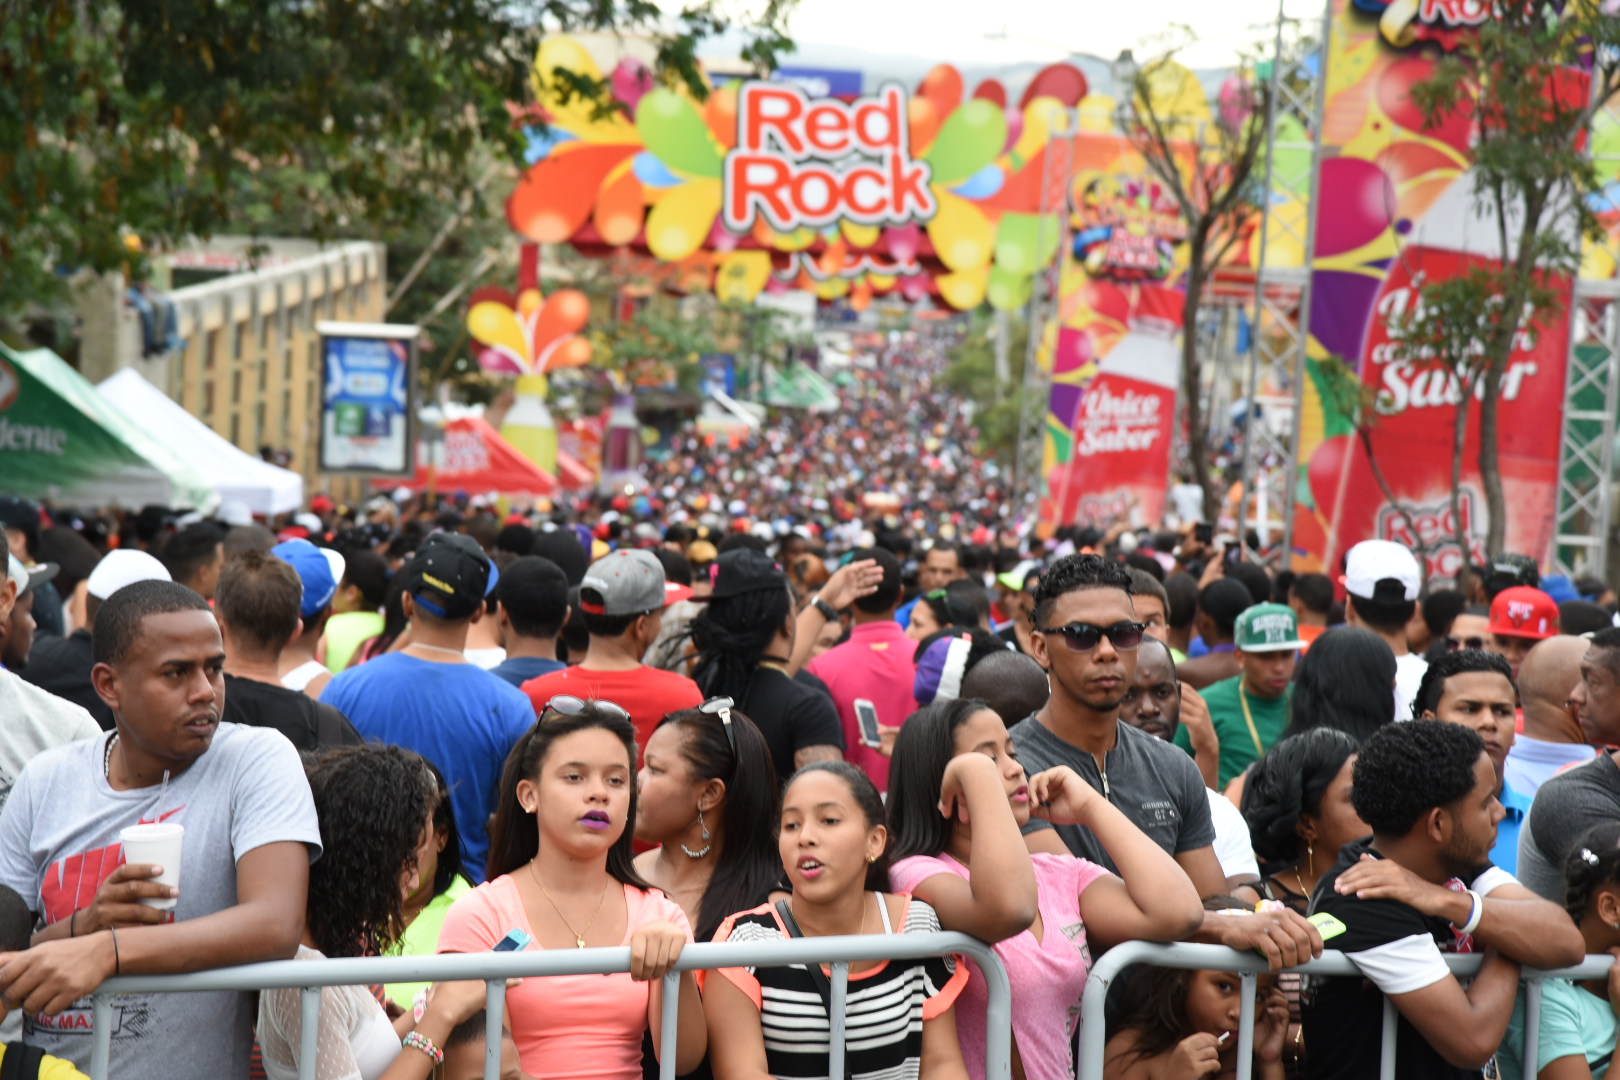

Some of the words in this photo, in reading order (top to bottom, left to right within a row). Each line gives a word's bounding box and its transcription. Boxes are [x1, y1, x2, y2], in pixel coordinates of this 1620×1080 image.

[744, 86, 903, 154] Red
[730, 152, 932, 225] Rock
[1384, 495, 1469, 546] Red
